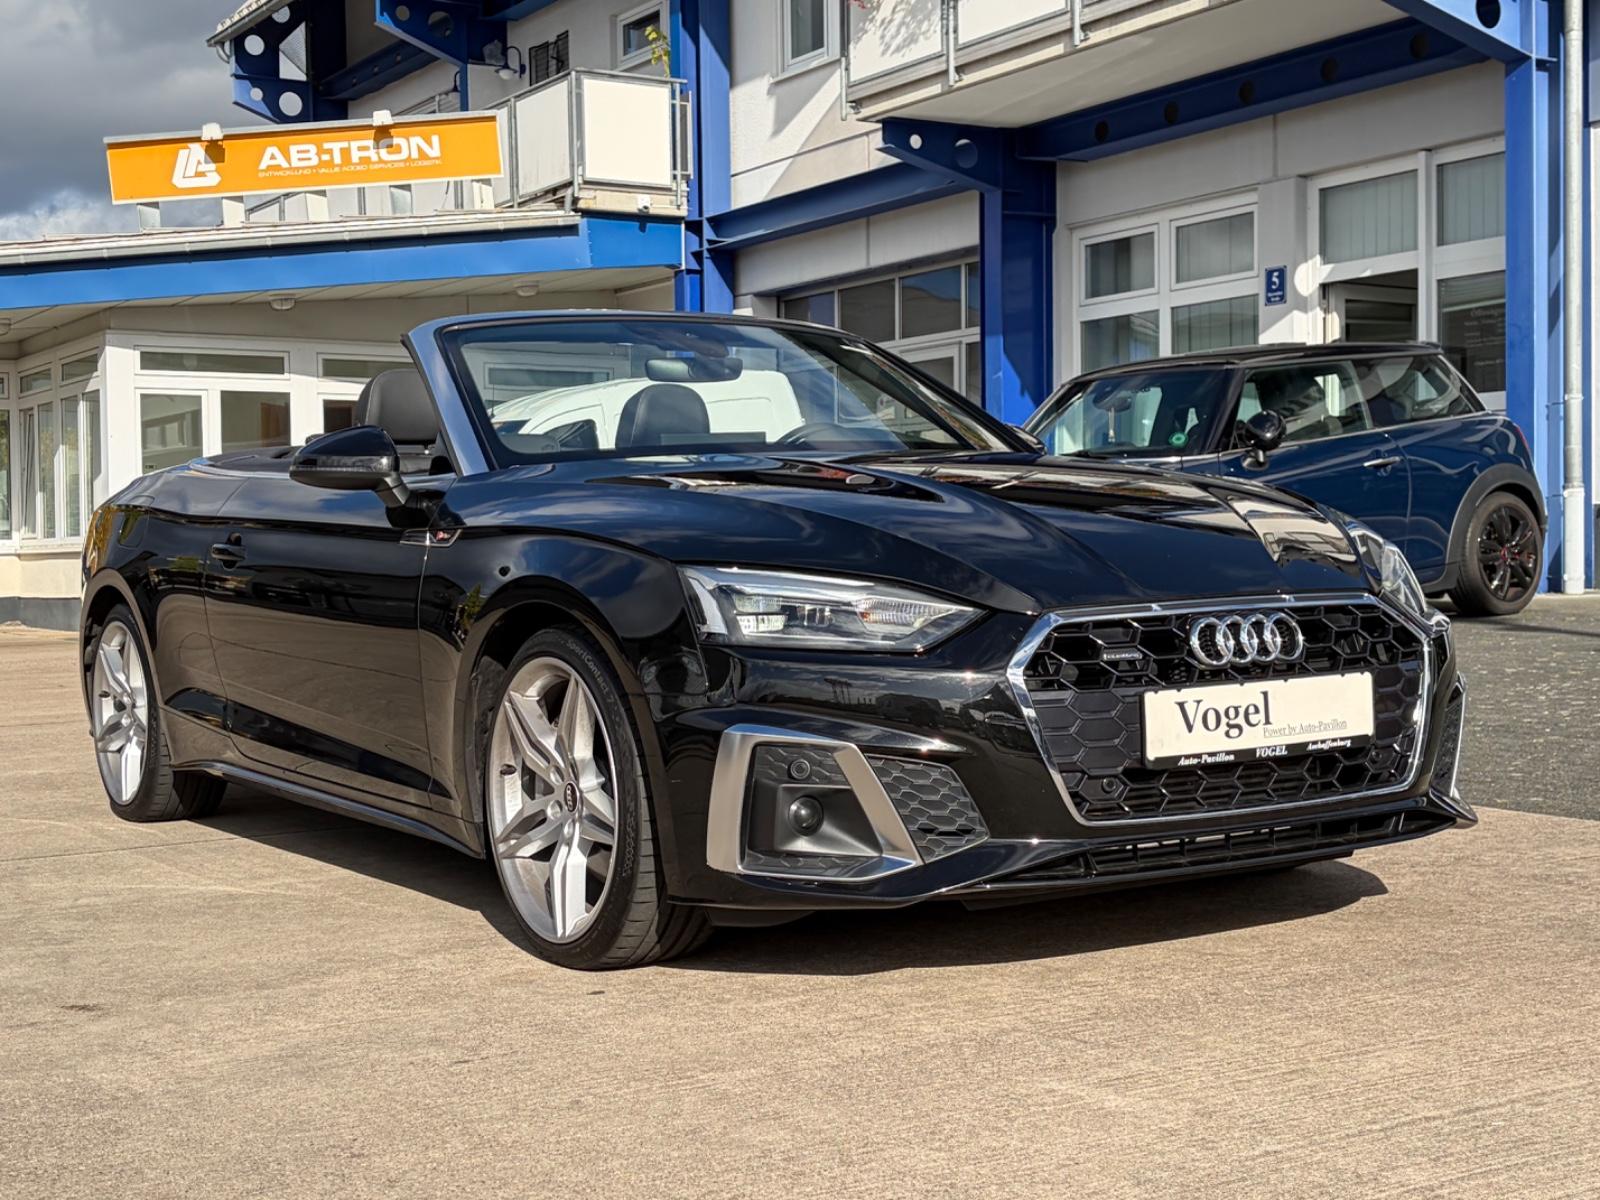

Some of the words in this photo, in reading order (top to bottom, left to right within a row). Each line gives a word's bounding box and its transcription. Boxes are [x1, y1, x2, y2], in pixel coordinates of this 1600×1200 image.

[258, 135, 441, 170] AB-TRON
[1271, 271, 1280, 289] 5
[1174, 690, 1273, 740] Vogel
[1263, 725, 1287, 737] Power
[1288, 723, 1297, 736] by
[1299, 719, 1348, 734] Auto-Pavillon
[1178, 752, 1235, 766] Auto-Pavillon
[1255, 745, 1288, 758] VOGEL
